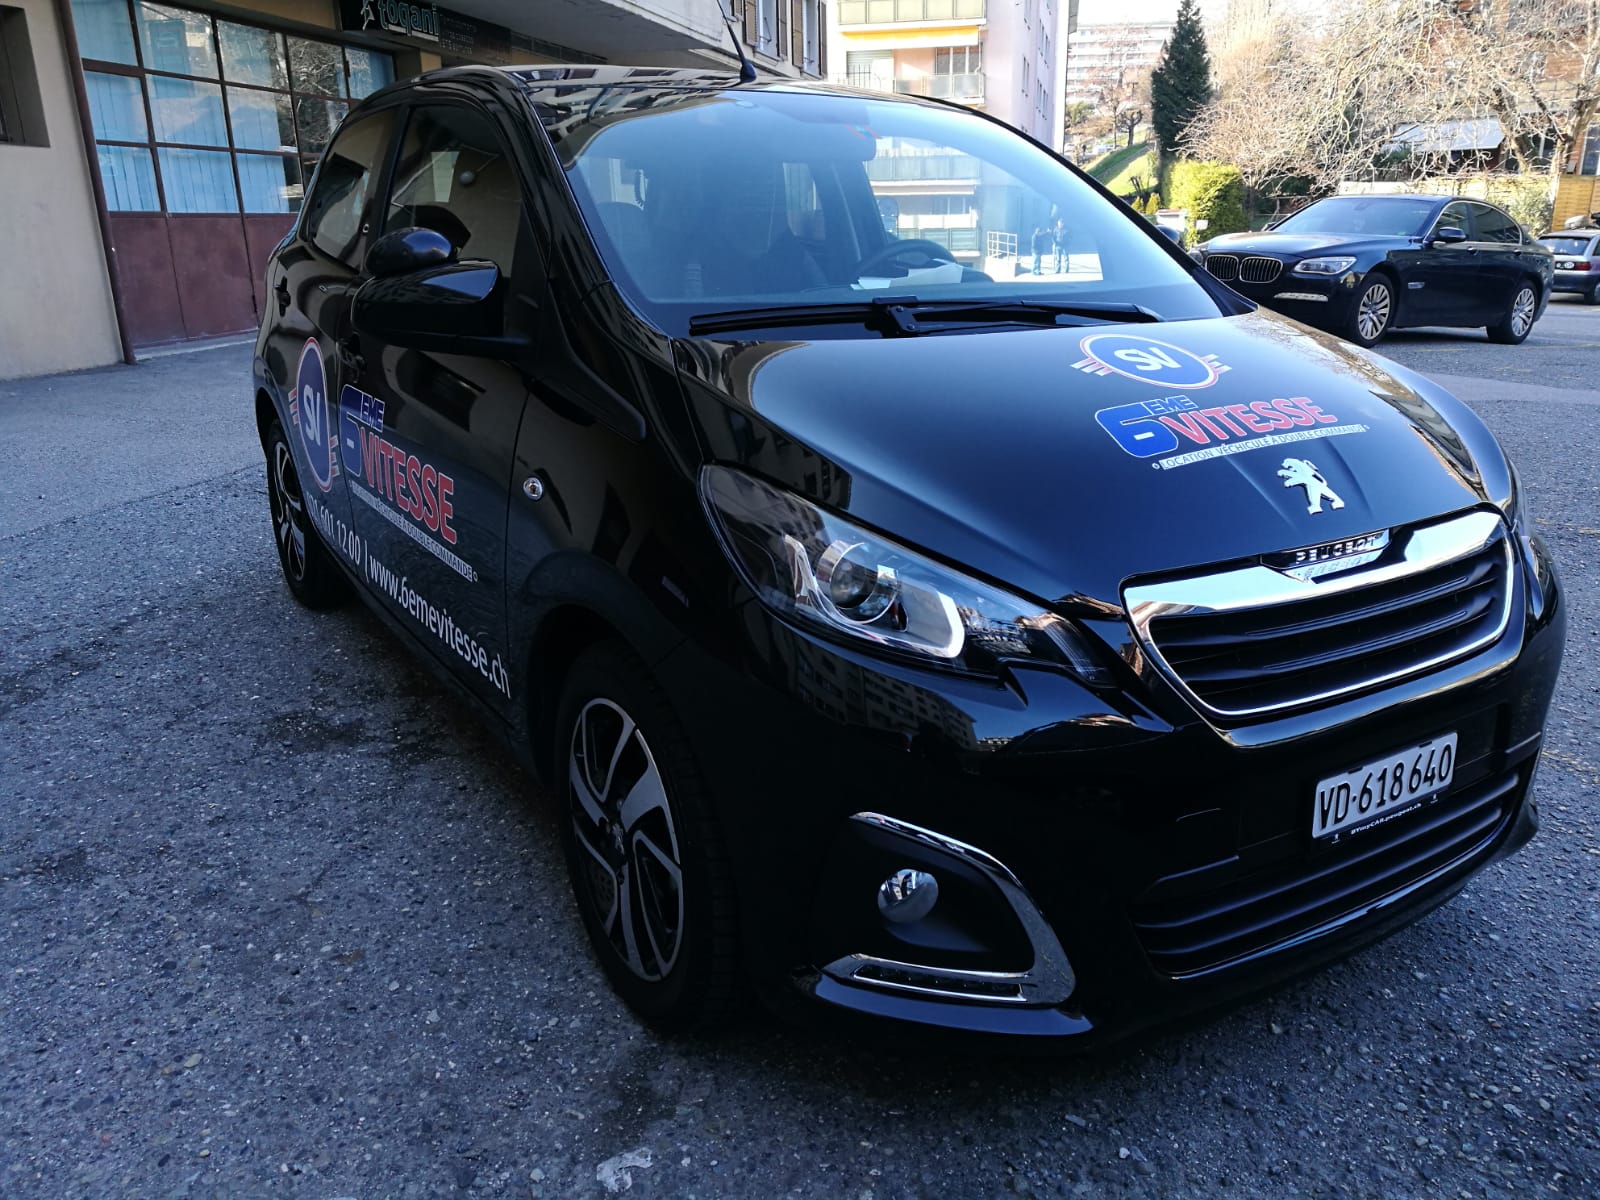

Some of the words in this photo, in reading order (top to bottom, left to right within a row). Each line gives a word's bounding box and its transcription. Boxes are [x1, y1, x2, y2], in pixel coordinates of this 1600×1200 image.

[1114, 346, 1182, 371] SV
[303, 384, 321, 446] SV
[1158, 397, 1338, 444] VITESSE
[1161, 449, 1213, 469] LOCATION
[1278, 431, 1314, 445] DOUBLE
[360, 426, 457, 544] VITESSE
[432, 538, 472, 582] COMMANDE
[1295, 535, 1376, 564] PEUGEOT
[369, 555, 511, 699] www.6emevitesse.ch
